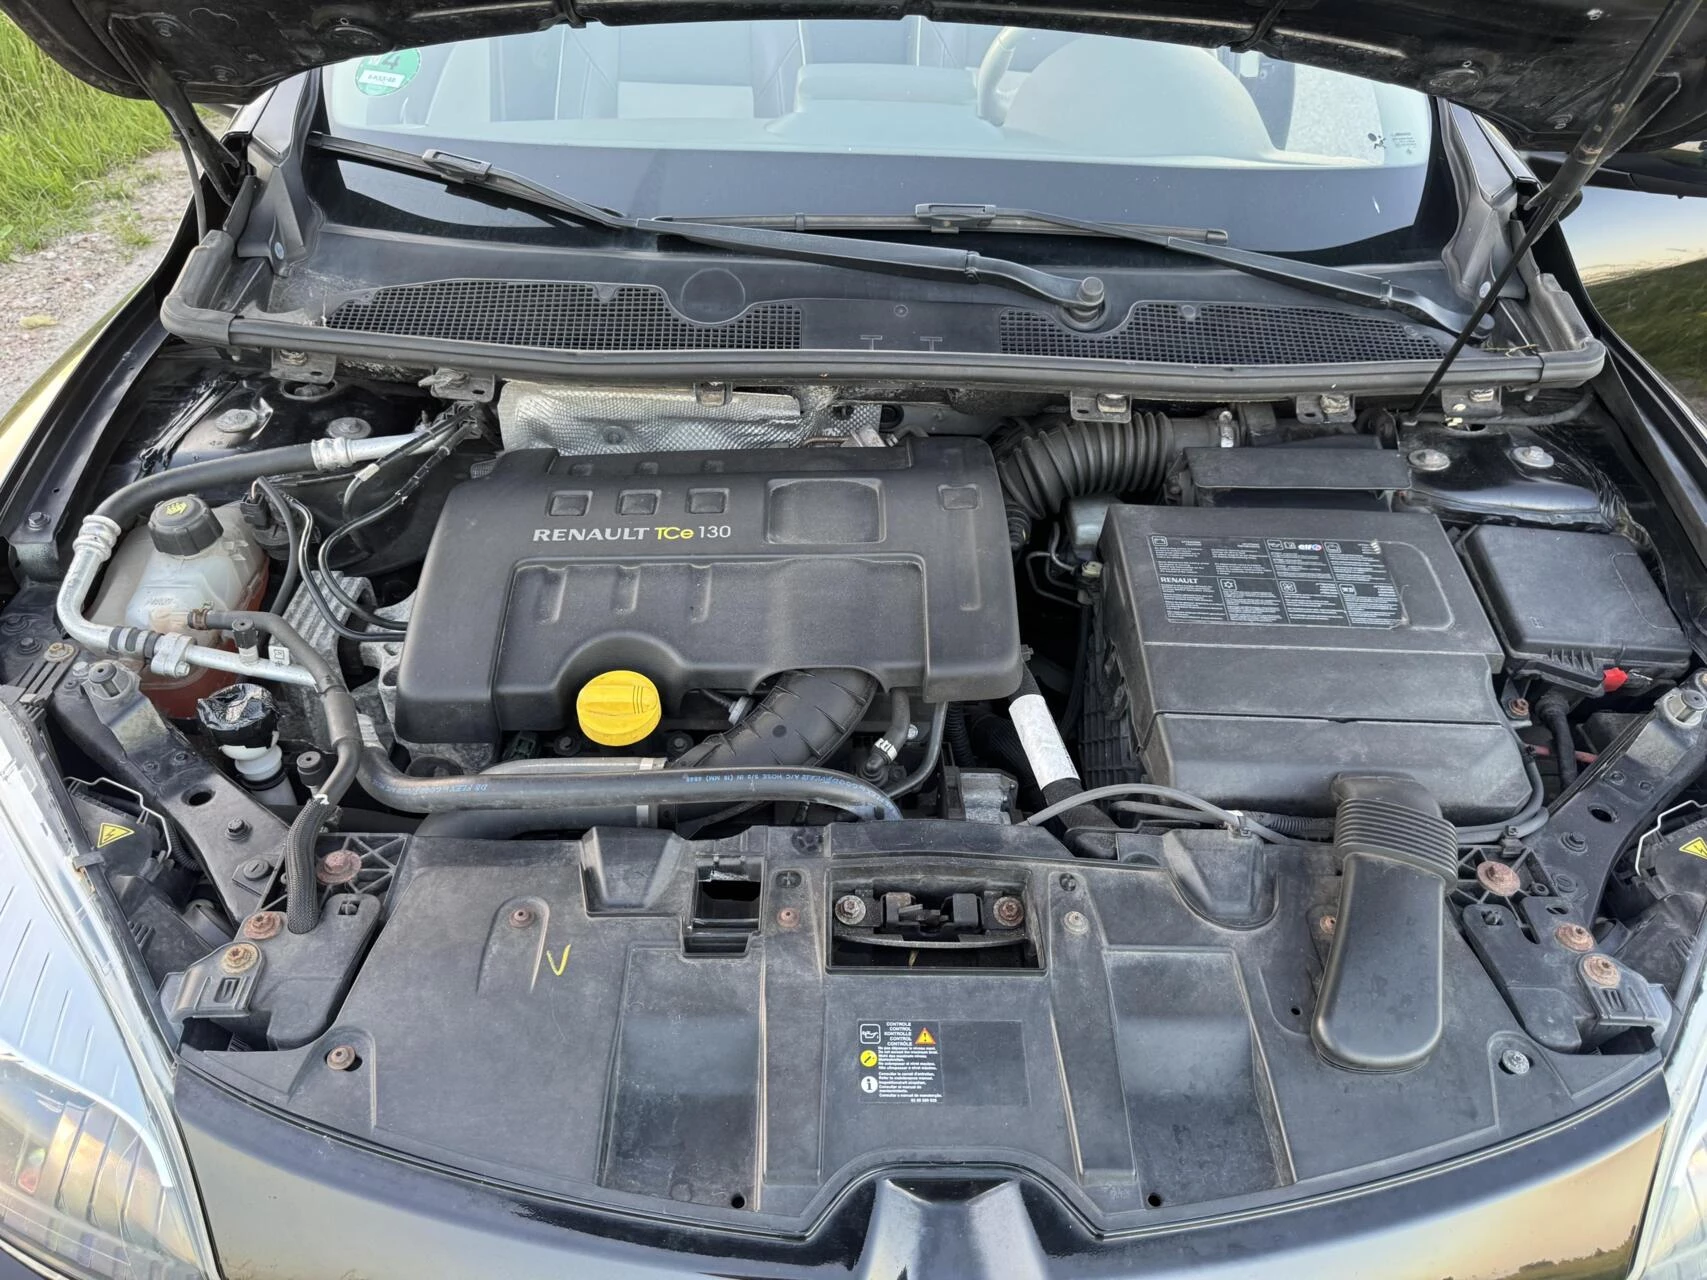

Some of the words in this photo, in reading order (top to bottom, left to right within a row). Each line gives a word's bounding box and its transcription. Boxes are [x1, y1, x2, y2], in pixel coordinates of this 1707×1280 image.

[382, 52, 400, 70] 4
[533, 527, 650, 542] RENAULT
[654, 526, 694, 540] TCe
[698, 525, 732, 539] 130
[1160, 576, 1199, 585] RENAULT
